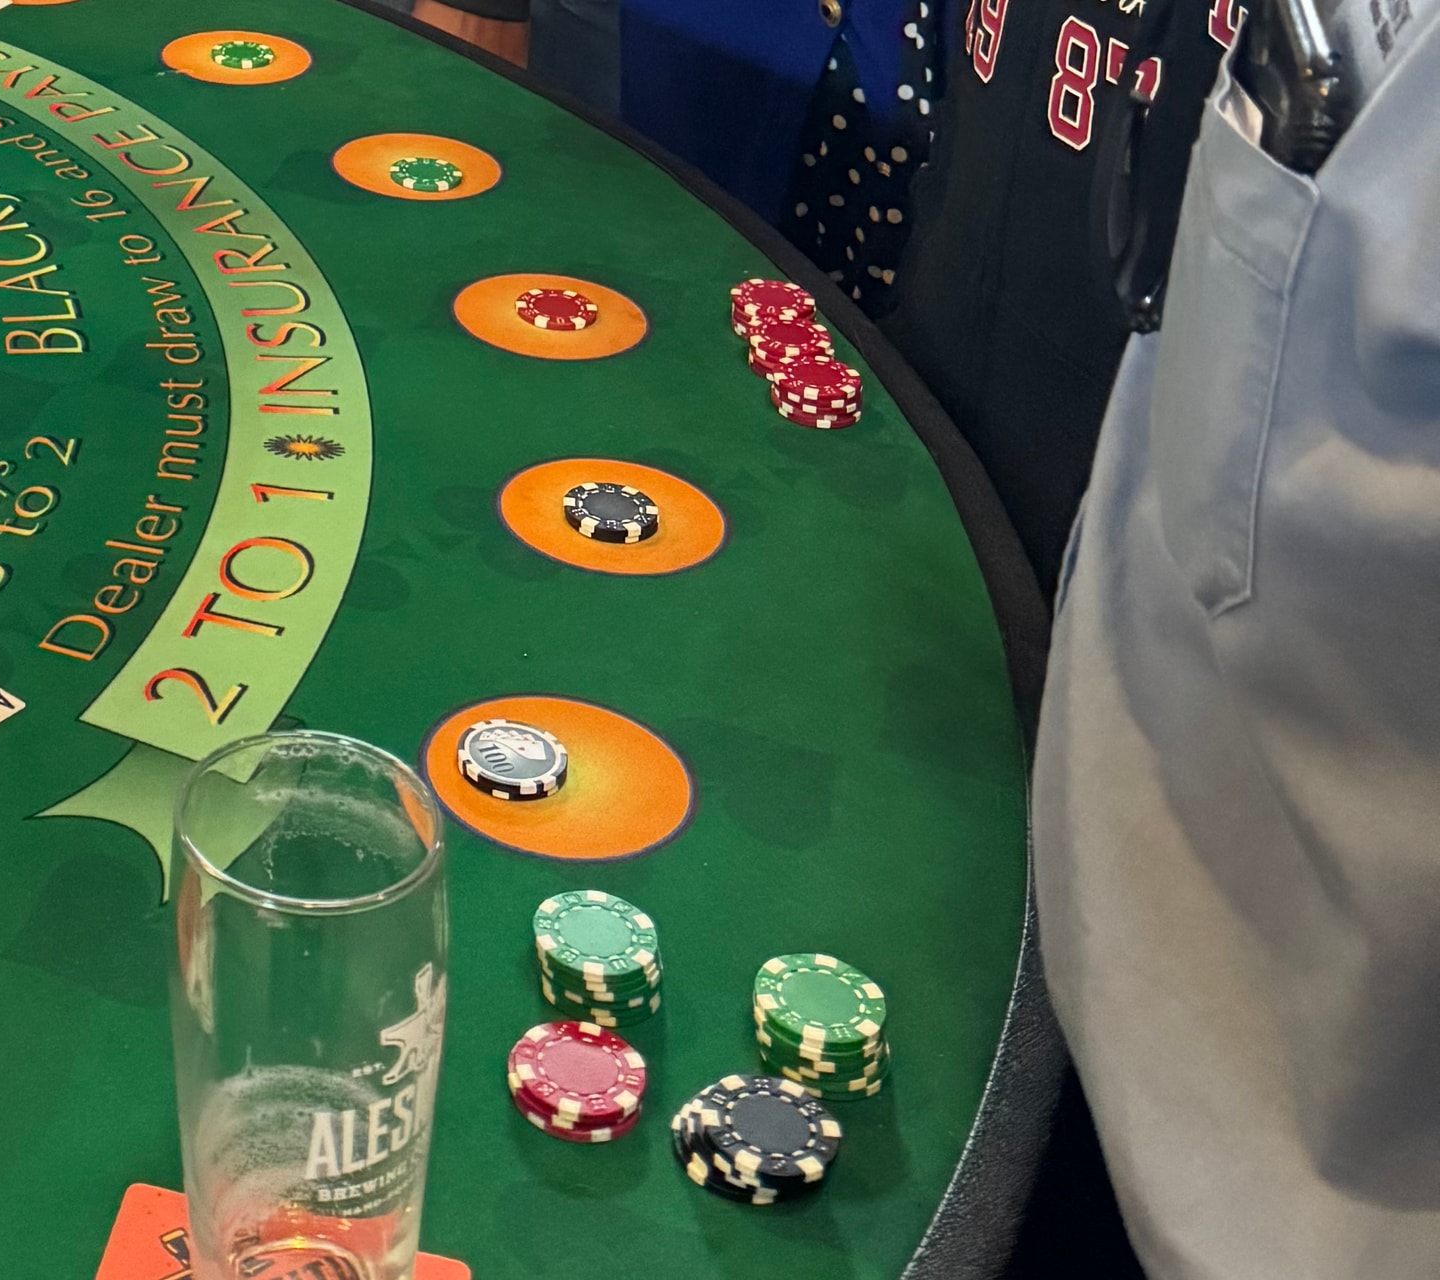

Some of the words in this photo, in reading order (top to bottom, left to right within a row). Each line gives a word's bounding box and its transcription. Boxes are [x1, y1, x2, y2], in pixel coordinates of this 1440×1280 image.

[70, 189, 128, 224] 16
[92, 123, 341, 417] INSURANCE
[119, 234, 162, 266] to
[141, 276, 202, 365] draw
[24, 435, 77, 467] 2
[157, 378, 205, 481] must
[249, 482, 335, 504] 1
[38, 494, 185, 661] Dealer
[181, 535, 316, 639] TO
[143, 667, 249, 726] 2
[478, 743, 515, 774] 100
[317, 1160, 409, 1203] BREWING
